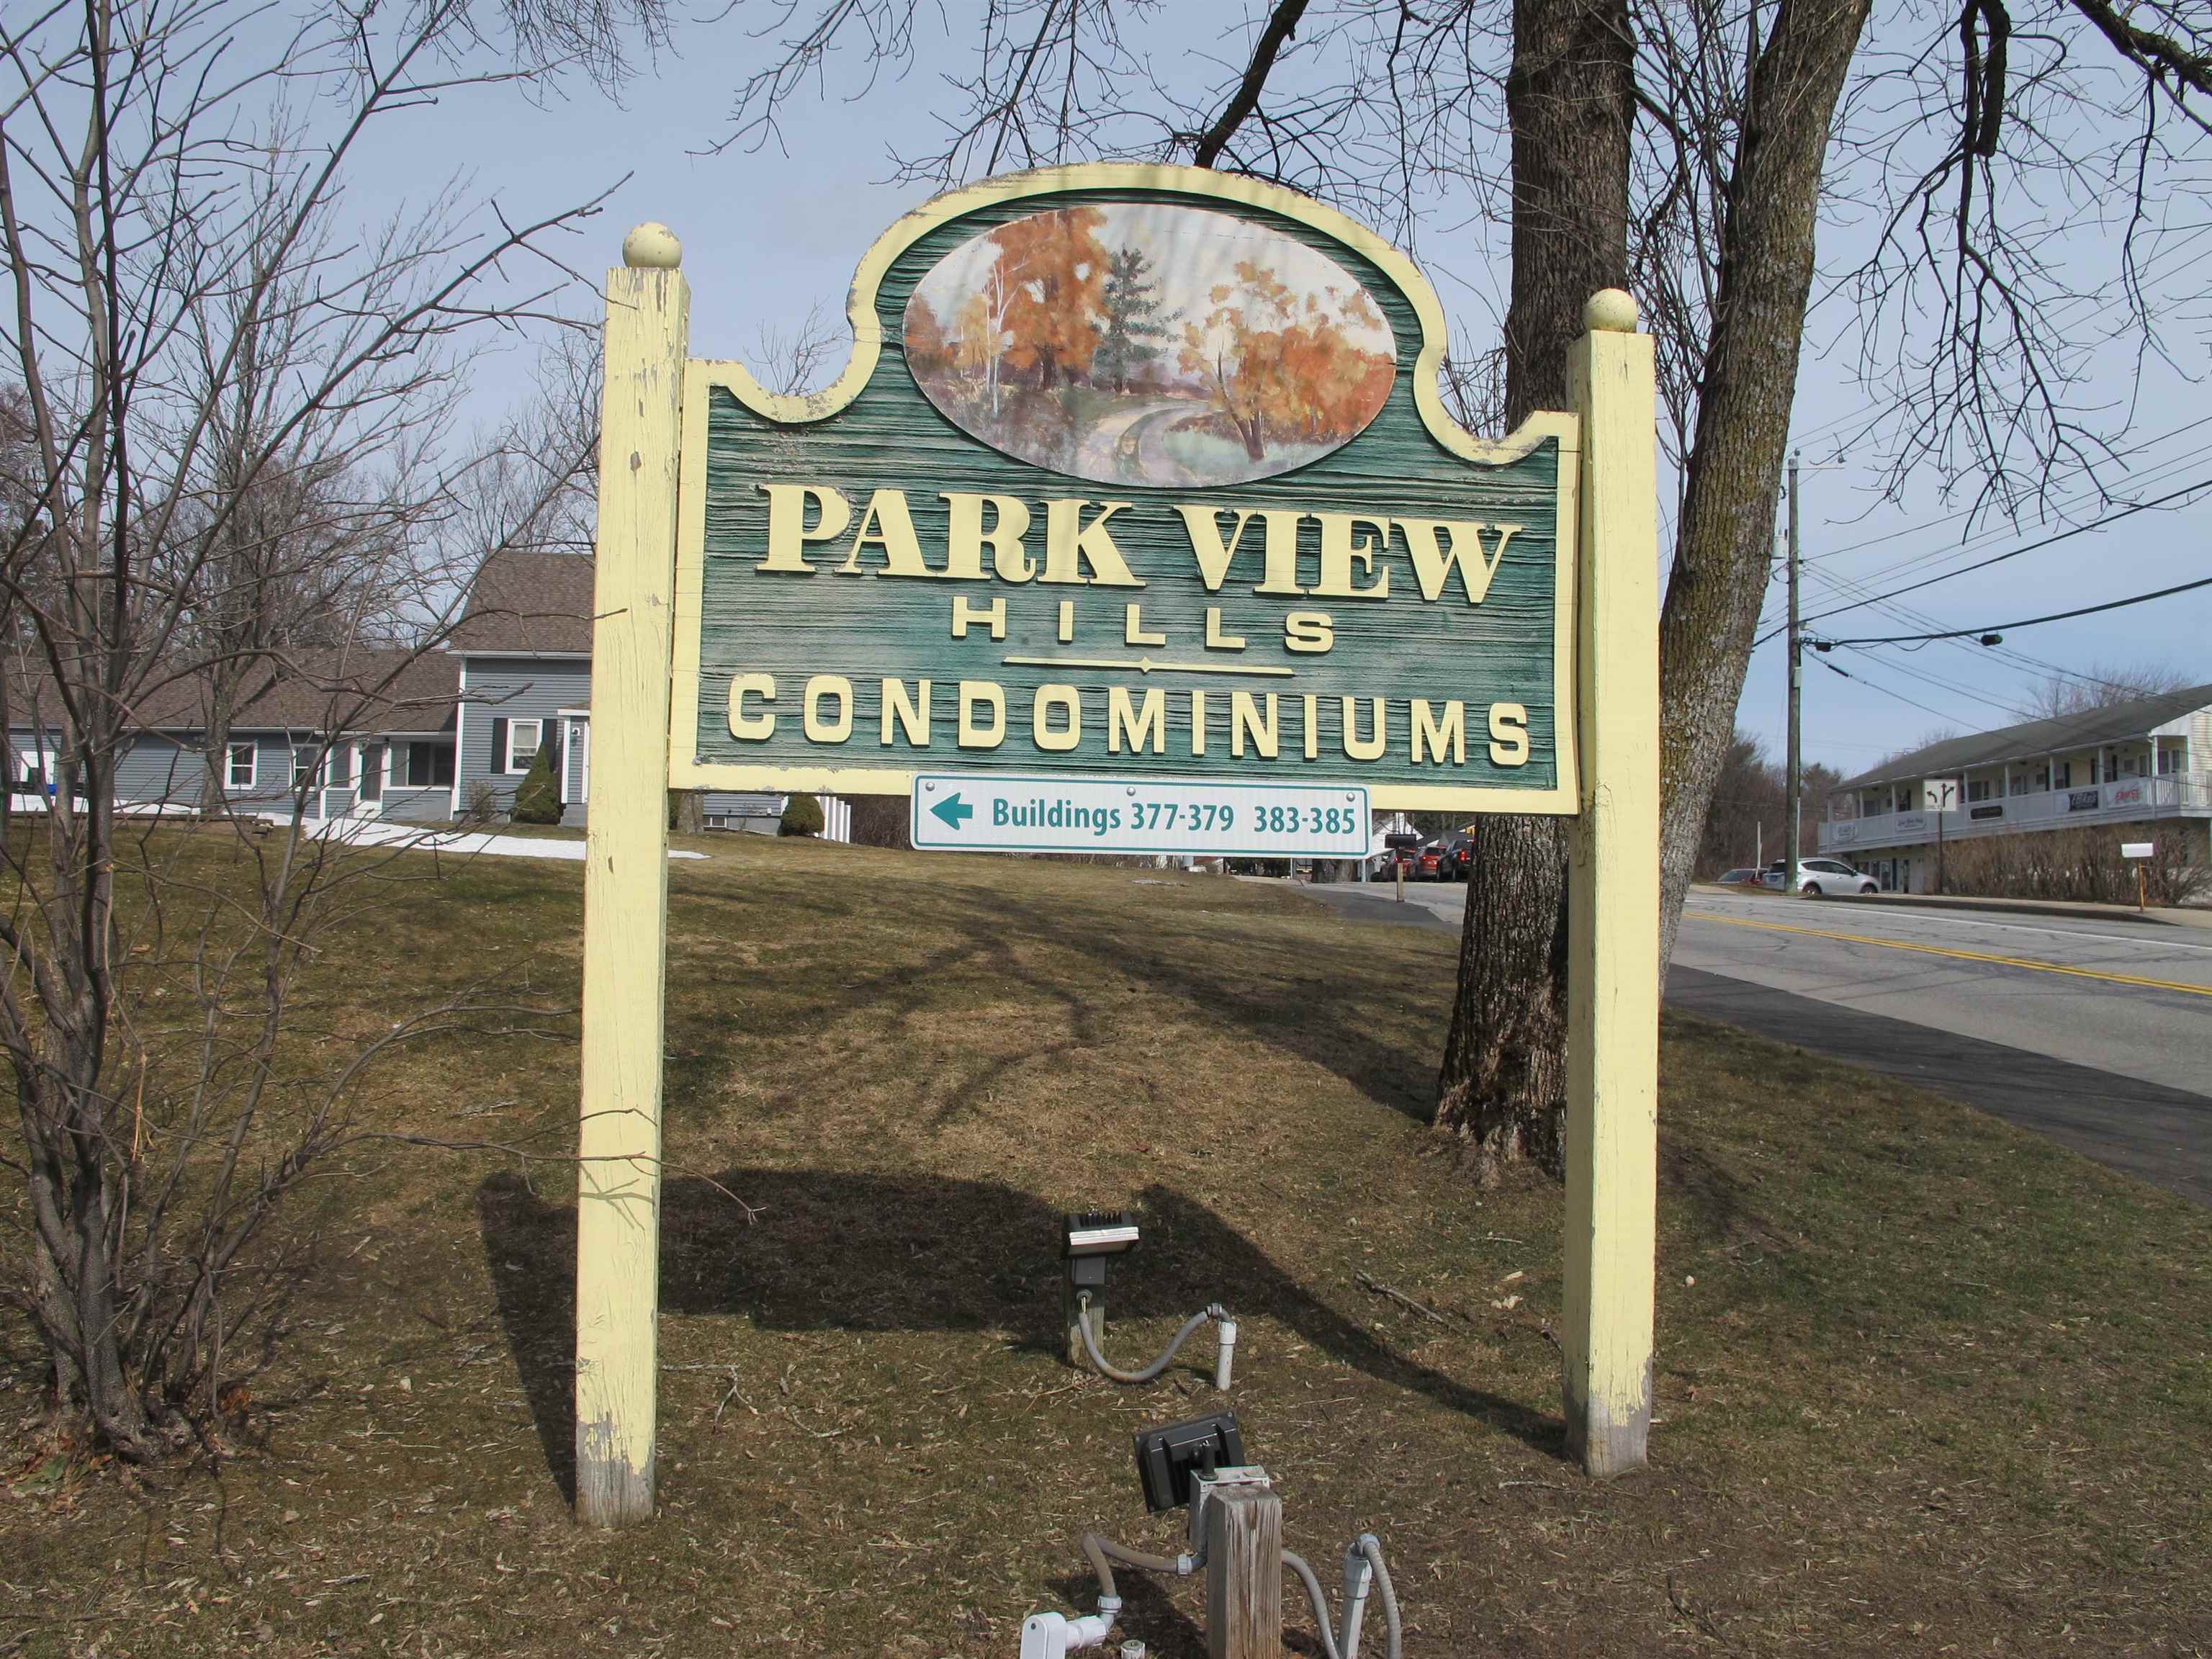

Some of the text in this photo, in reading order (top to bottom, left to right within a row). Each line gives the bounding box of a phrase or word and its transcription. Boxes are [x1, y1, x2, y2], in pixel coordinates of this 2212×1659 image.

[756, 483, 1523, 604] PARK VIEW
[951, 595, 1334, 652] HILLS
[727, 672, 1530, 766] CONDOMINIUMS
[992, 797, 1356, 836] Buildings 377-379 383-385
